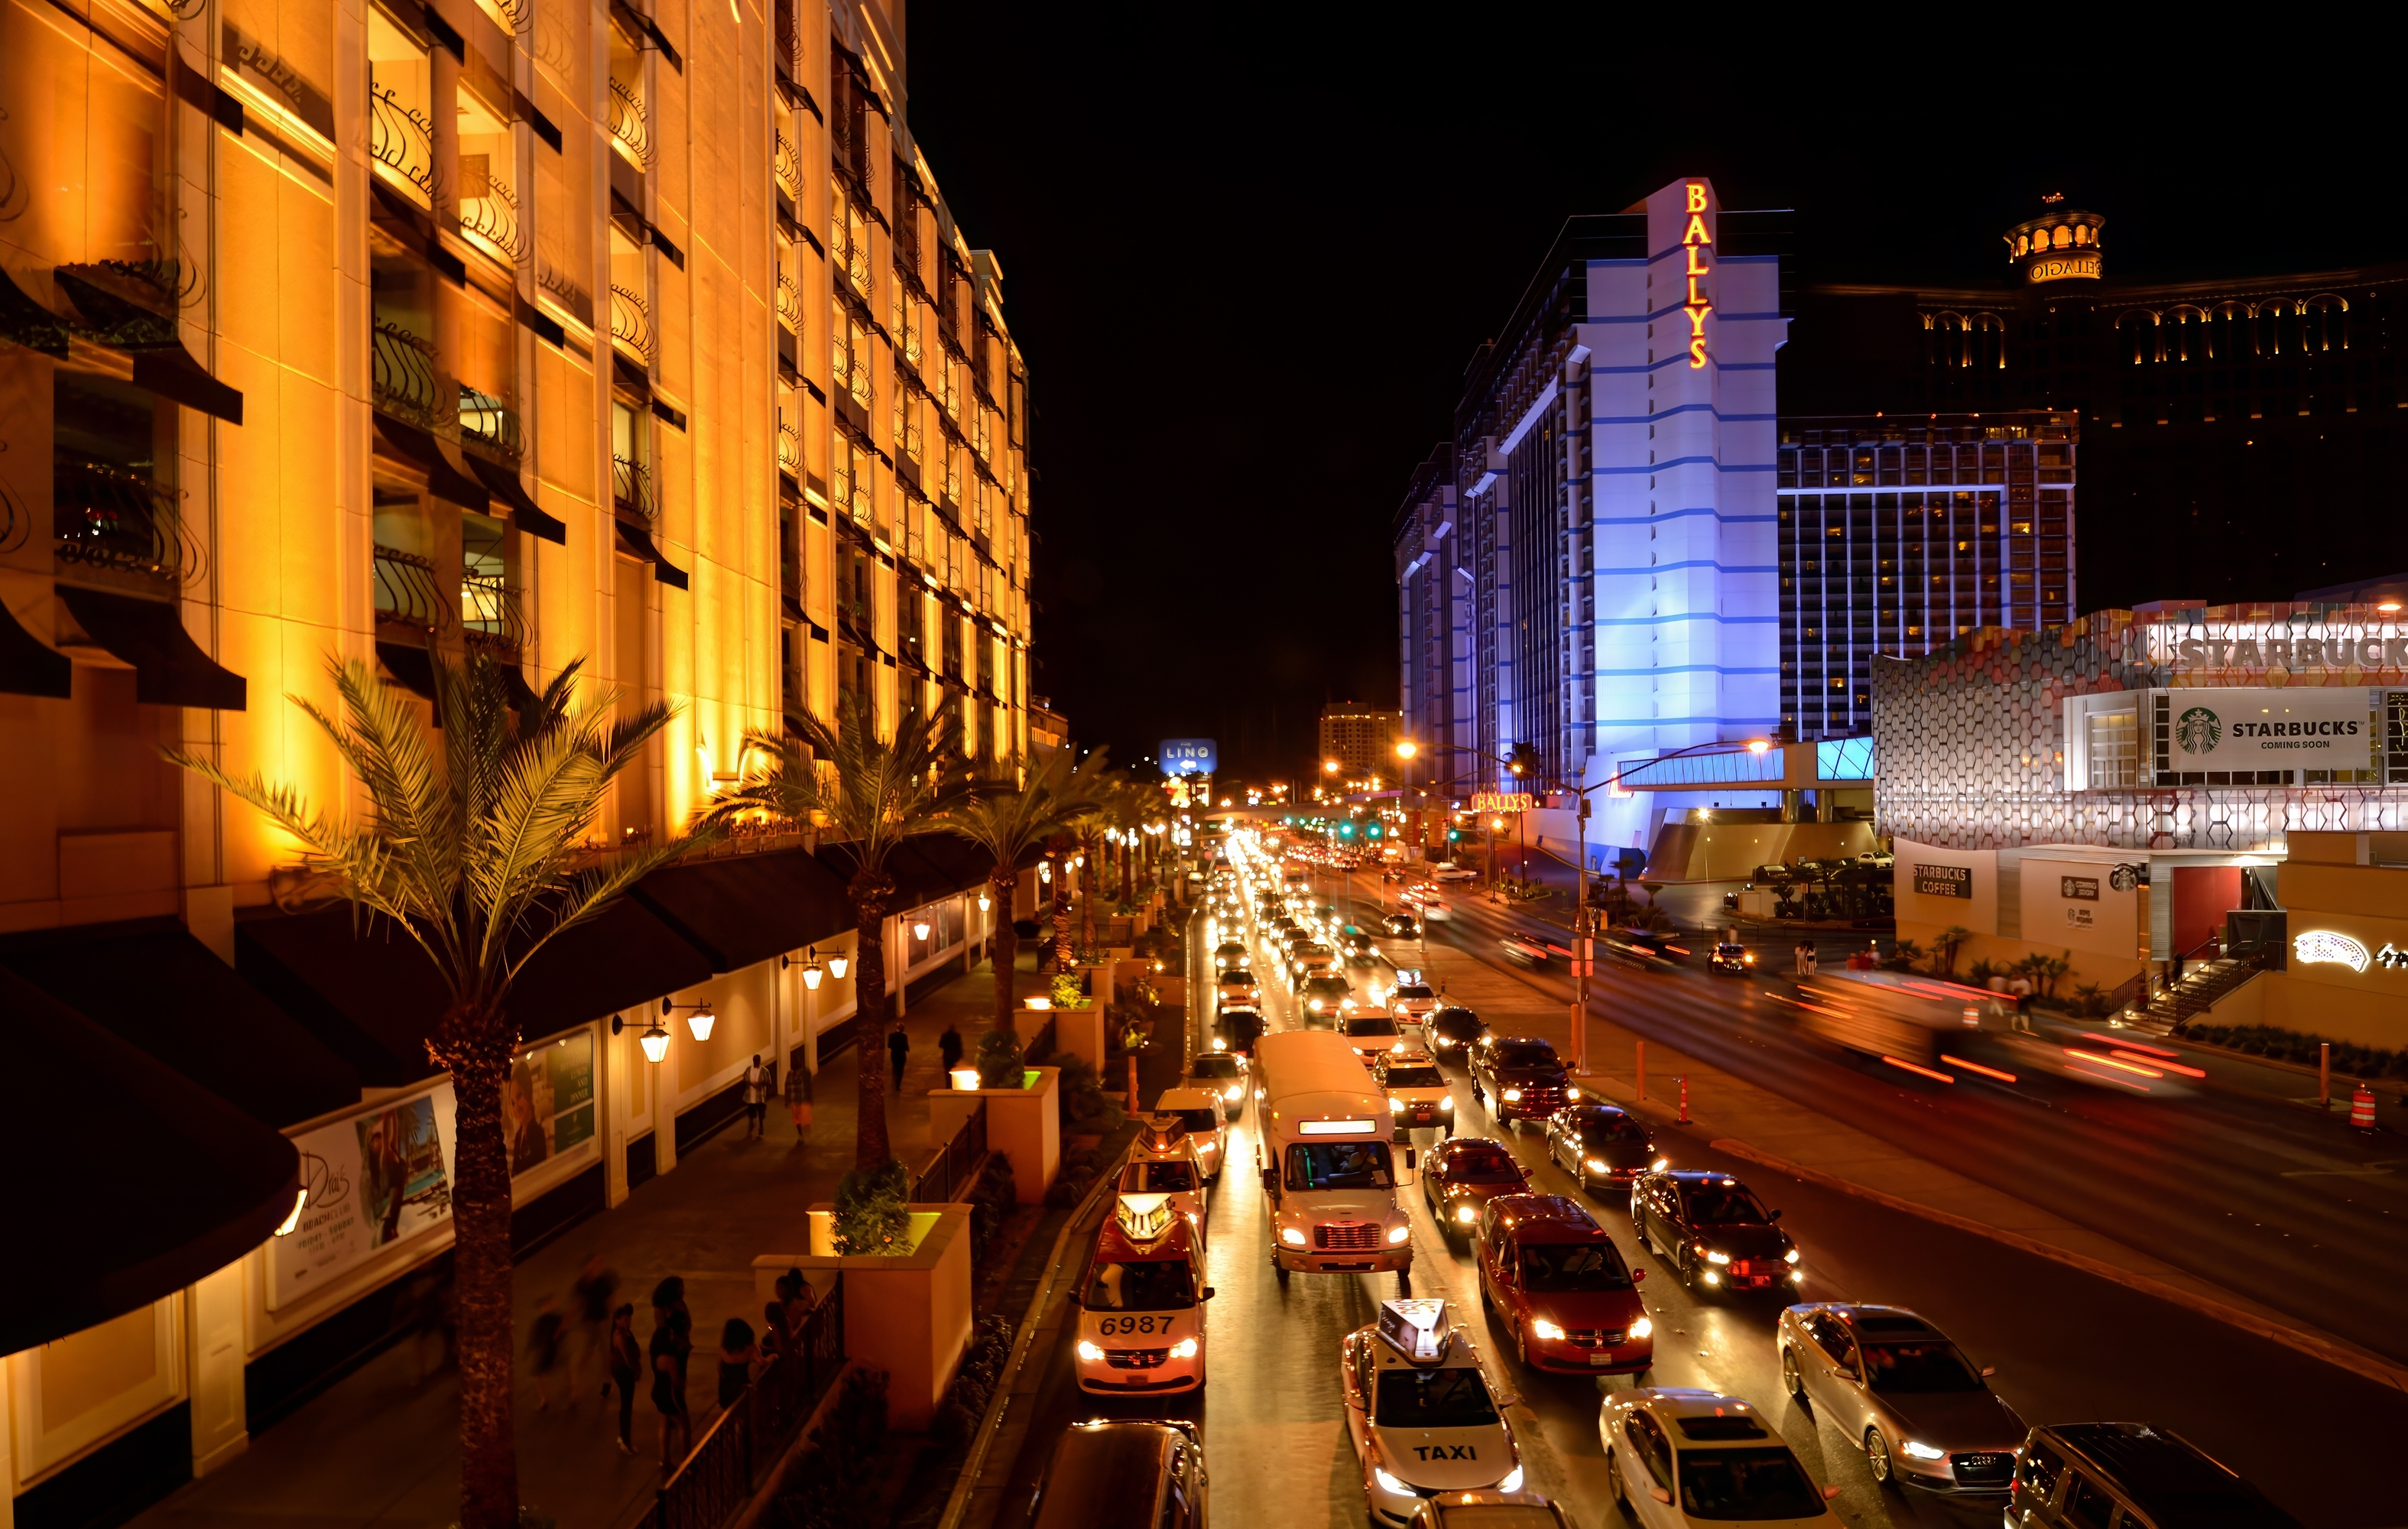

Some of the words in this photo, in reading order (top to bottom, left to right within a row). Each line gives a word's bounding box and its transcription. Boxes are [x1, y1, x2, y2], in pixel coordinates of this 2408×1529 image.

[1683, 183, 1712, 368] BALLYS
[2232, 721, 2358, 738] STARBUCKS
[1913, 865, 1966, 881] STARBUCKS
[1922, 881, 1956, 895] COFFEE
[1100, 1316, 1175, 1336] 6987
[1413, 1445, 1477, 1461] TAXI
